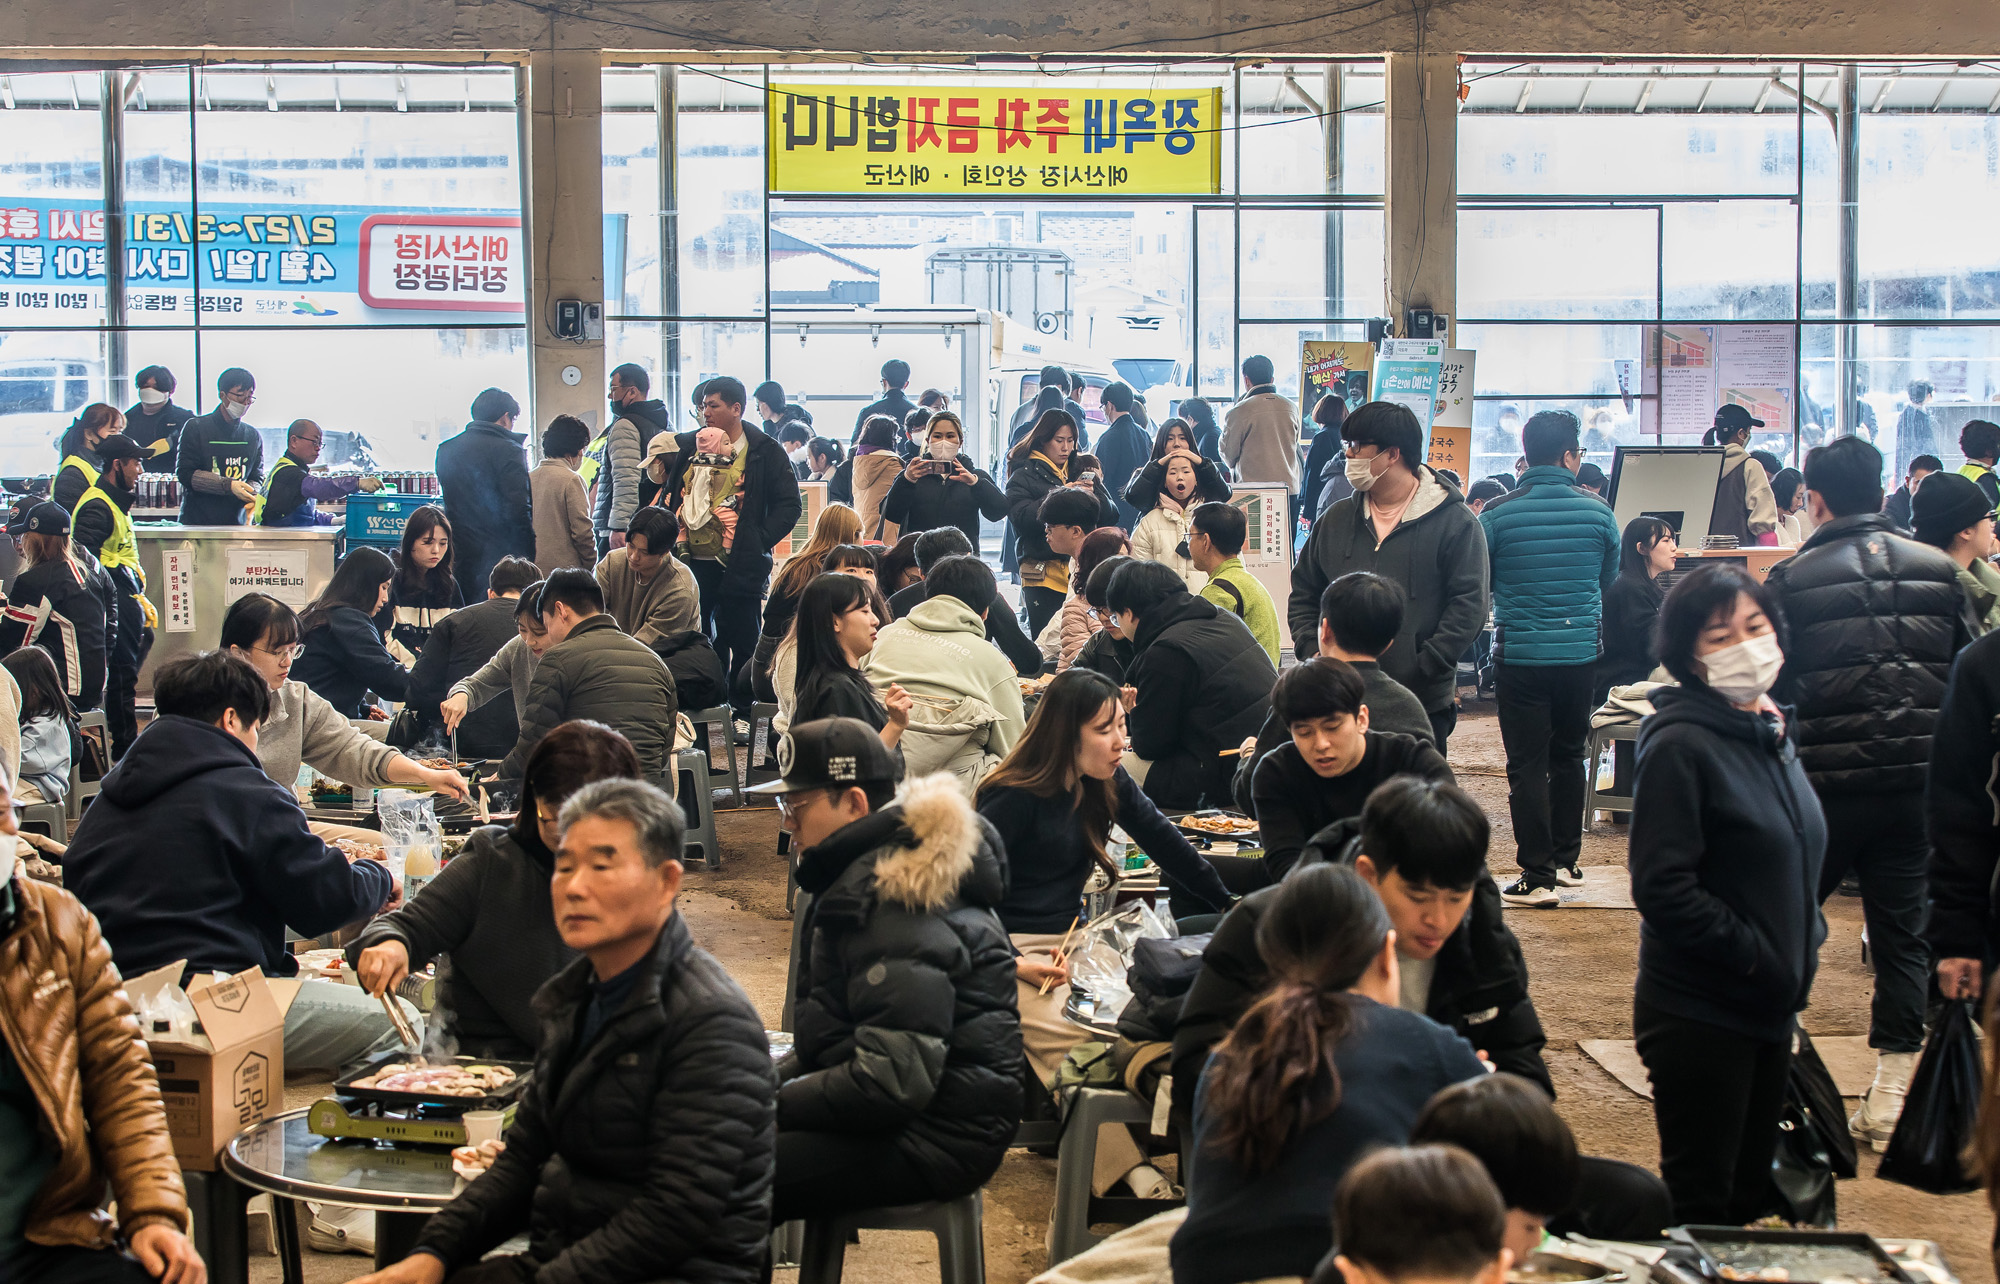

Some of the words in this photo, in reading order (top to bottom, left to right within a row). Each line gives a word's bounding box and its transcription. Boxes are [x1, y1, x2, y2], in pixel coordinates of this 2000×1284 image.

[1412, 375, 1433, 390] 예산
[1266, 498, 1273, 511] 자리
[1266, 514, 1273, 528] 먼저
[170, 556, 178, 572] 자리
[245, 566, 289, 576] 부탄가스는
[171, 575, 180, 592] 먼저
[229, 576, 254, 587] 여기서
[255, 576, 305, 587] 바꿔드립니다
[172, 594, 180, 610] 확보
[172, 614, 181, 623] 후
